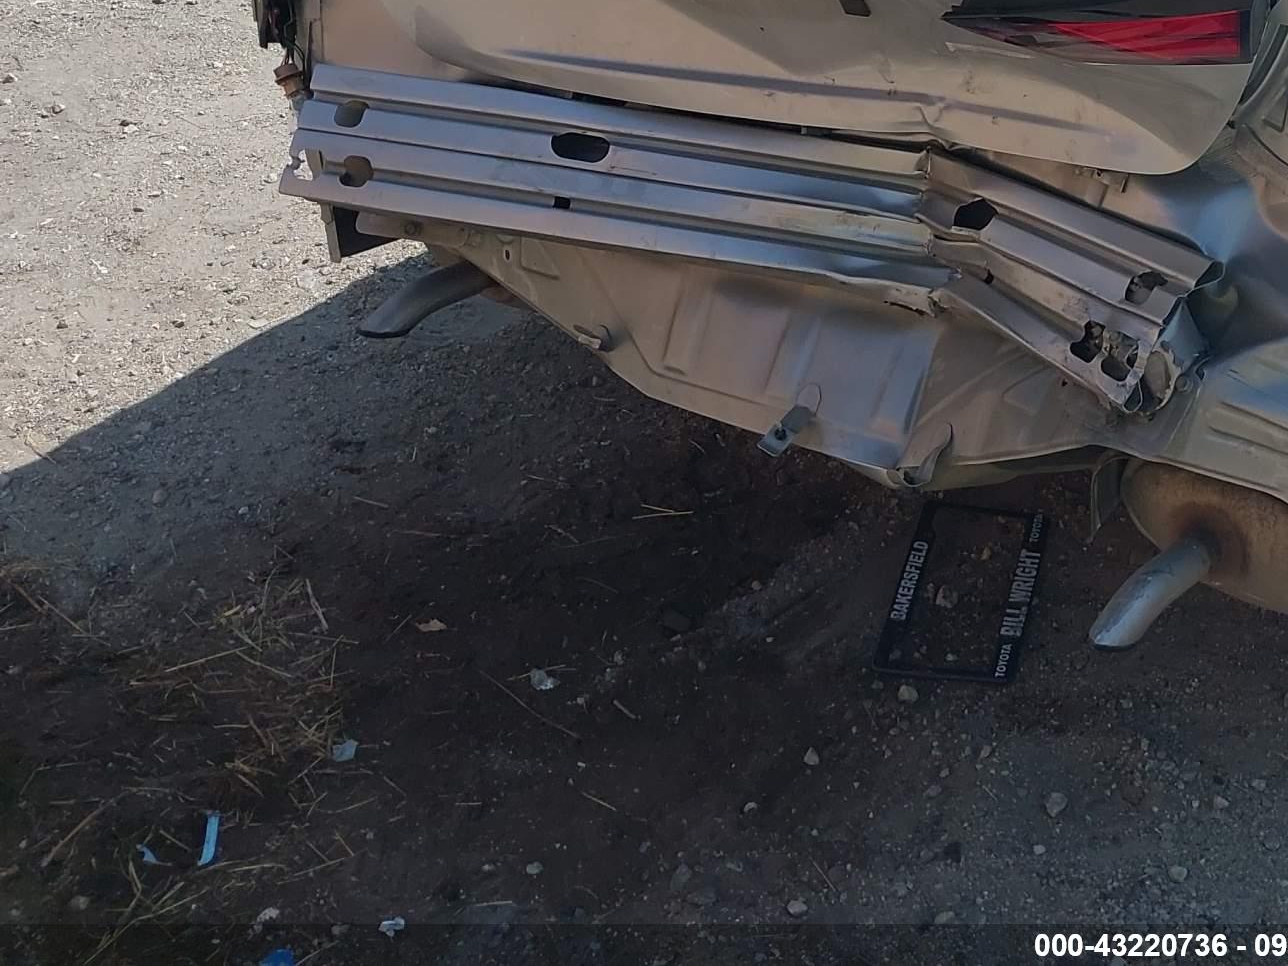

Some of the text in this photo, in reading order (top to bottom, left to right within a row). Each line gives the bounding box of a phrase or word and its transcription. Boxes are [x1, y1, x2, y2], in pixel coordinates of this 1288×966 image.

[890, 540, 930, 621] BAKERSFIELD
[1008, 548, 1042, 602] WRIGHT
[1000, 606, 1030, 637] BILL
[994, 643, 1013, 678] TOYOTA
